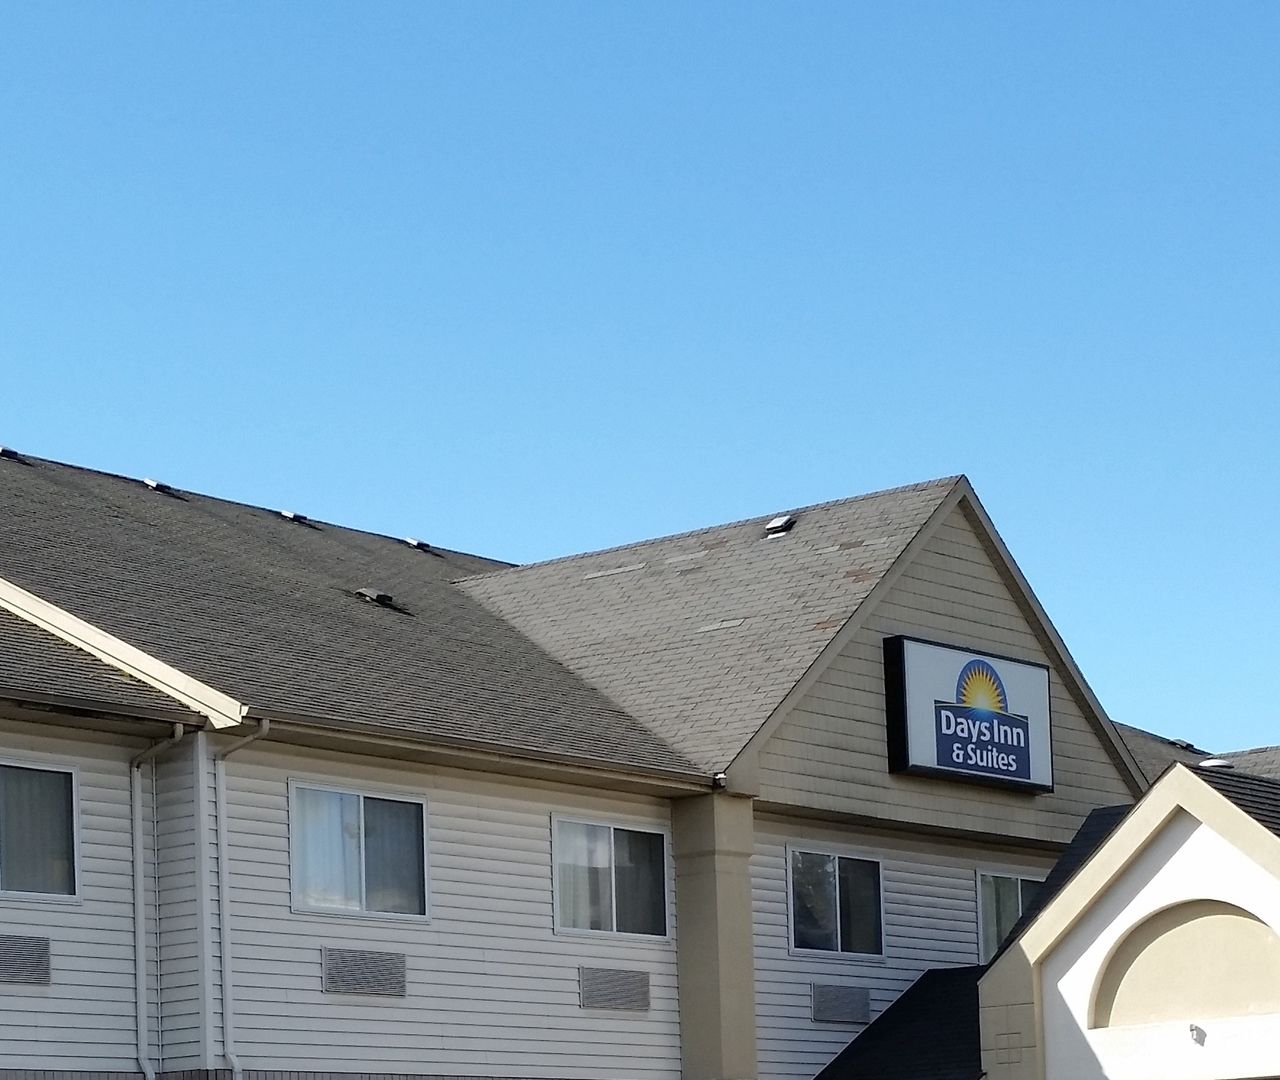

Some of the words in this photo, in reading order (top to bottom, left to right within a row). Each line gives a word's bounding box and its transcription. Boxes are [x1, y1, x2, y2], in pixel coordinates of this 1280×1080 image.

[941, 710, 990, 743] Days
[993, 719, 1024, 747] Inn
[952, 742, 964, 763] &
[967, 744, 1017, 771] Suites
